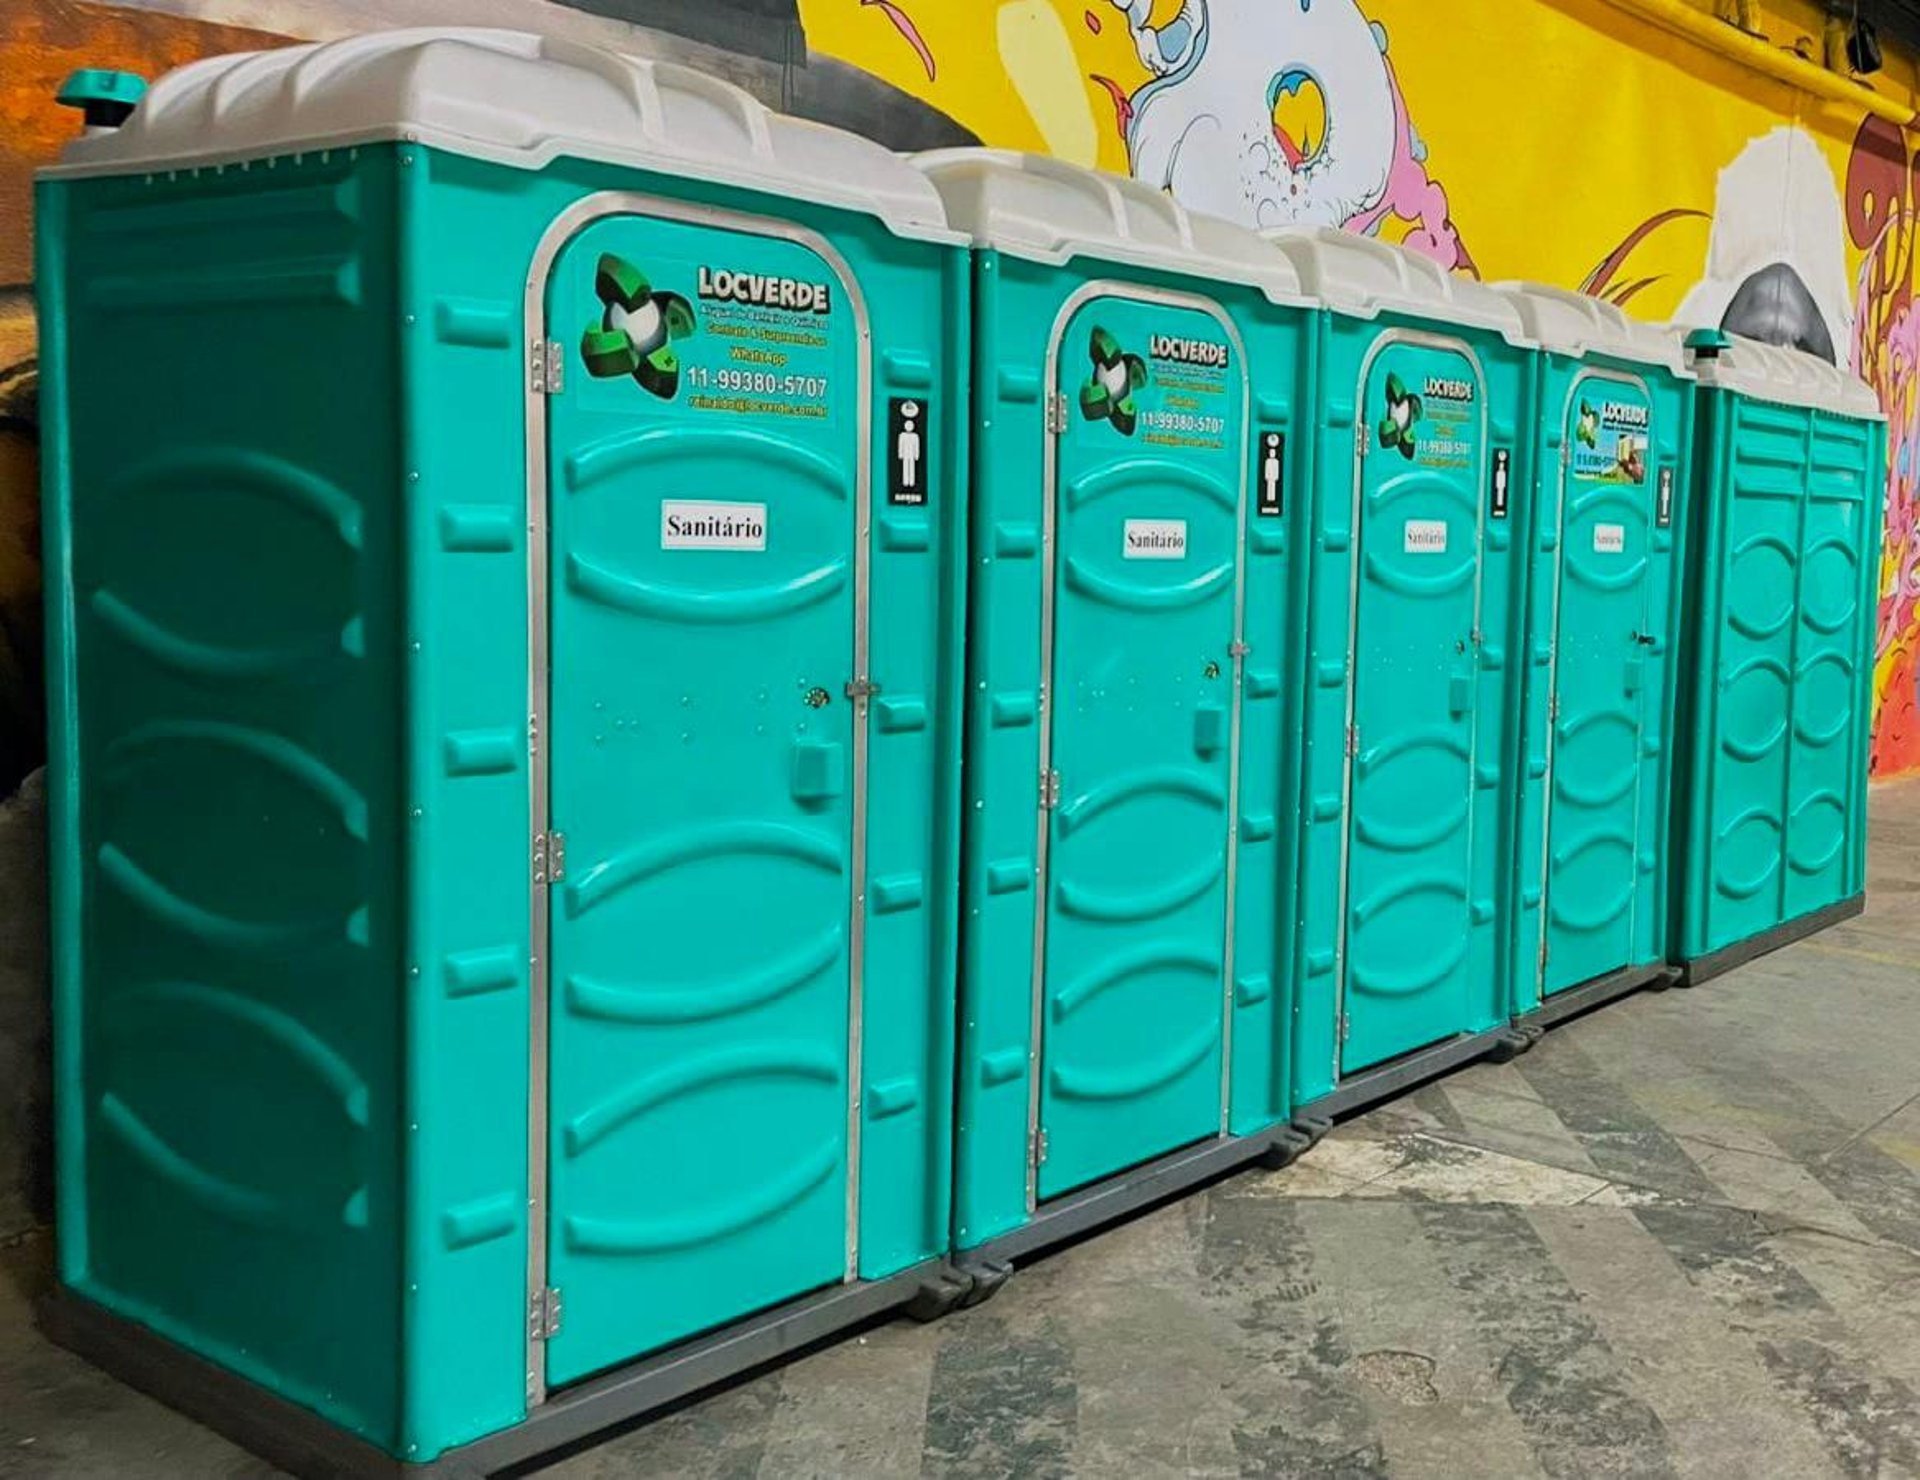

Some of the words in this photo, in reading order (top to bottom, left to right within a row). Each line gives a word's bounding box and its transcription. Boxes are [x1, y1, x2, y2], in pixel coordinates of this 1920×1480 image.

[698, 266, 830, 315] LOCVERDE
[730, 347, 788, 367] WhatsApp
[1150, 335, 1229, 368] LOCVERDE
[687, 366, 828, 398] 11-99380-5707
[1141, 411, 1225, 434] 11-99380-5707
[667, 514, 763, 539] Sanitário
[1128, 530, 1184, 549] Sanitário
